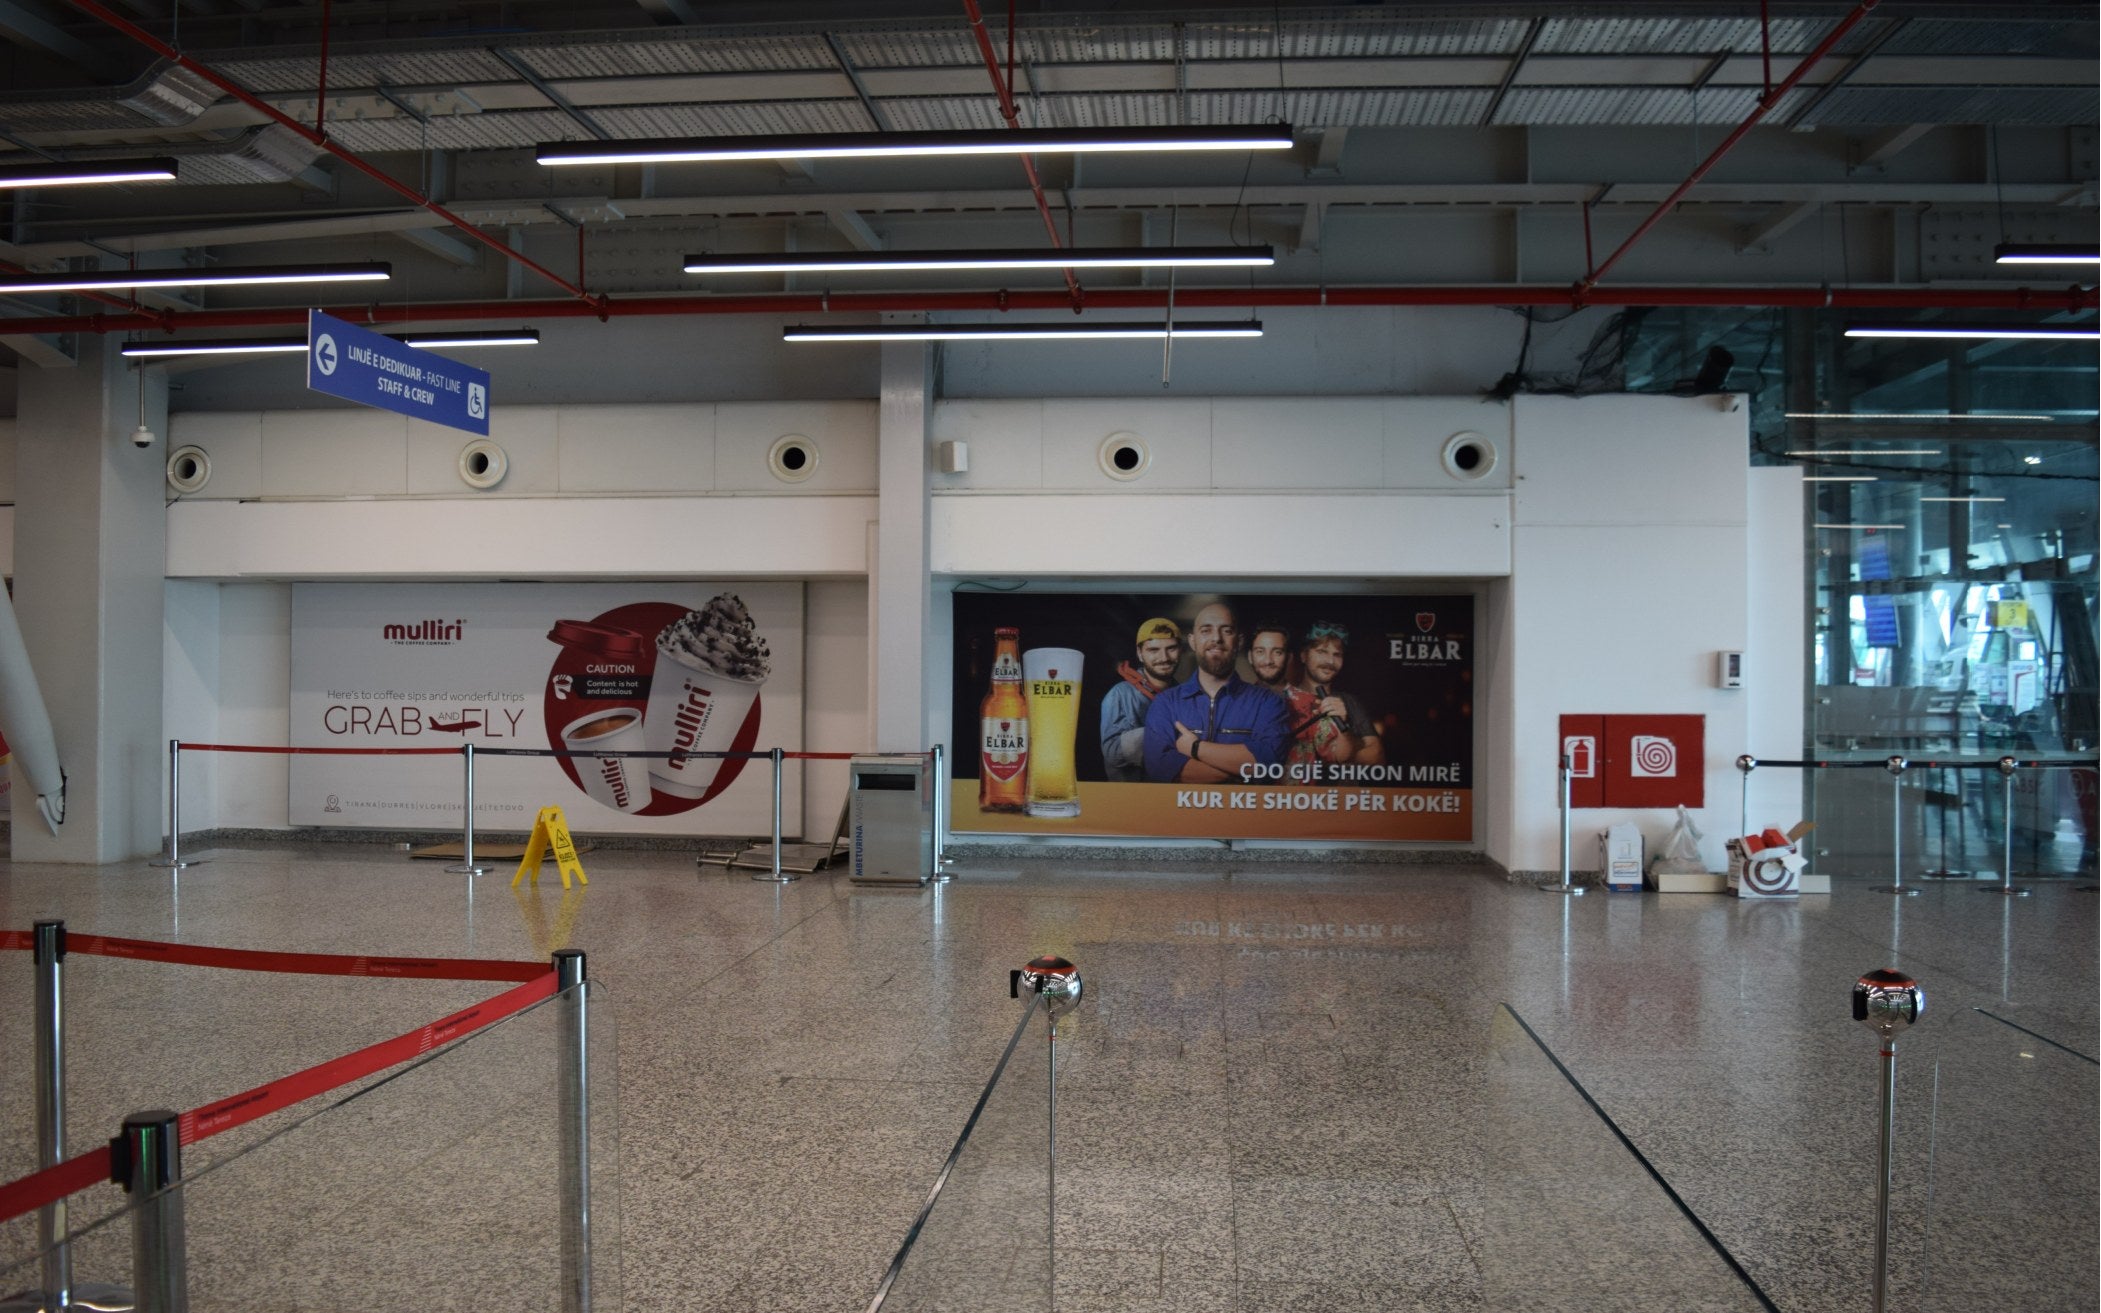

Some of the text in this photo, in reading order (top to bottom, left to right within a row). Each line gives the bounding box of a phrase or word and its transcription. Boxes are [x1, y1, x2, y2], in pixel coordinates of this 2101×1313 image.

[348, 345, 372, 365] LINJË
[373, 353, 378, 367] E
[379, 356, 421, 382] DEDIKUAR
[427, 371, 445, 389] FAST
[445, 377, 461, 394] LINE
[378, 377, 434, 406] STAFF & CREW
[384, 618, 462, 640] mulliri
[1389, 639, 1462, 660] ELBAR
[586, 664, 635, 674] CAUTION
[327, 690, 524, 703] Here's to coffee sips and wonderful trips
[1033, 684, 1072, 695] ELBAR
[325, 705, 524, 737] GRAB AND FLY
[668, 683, 712, 770] mulliri
[986, 736, 1024, 748] ELBAR
[1239, 760, 1461, 784] ÇDO GJË SHKON MIRË
[1177, 789, 1460, 813] KUR KE SHOKË PËR KOKË!
